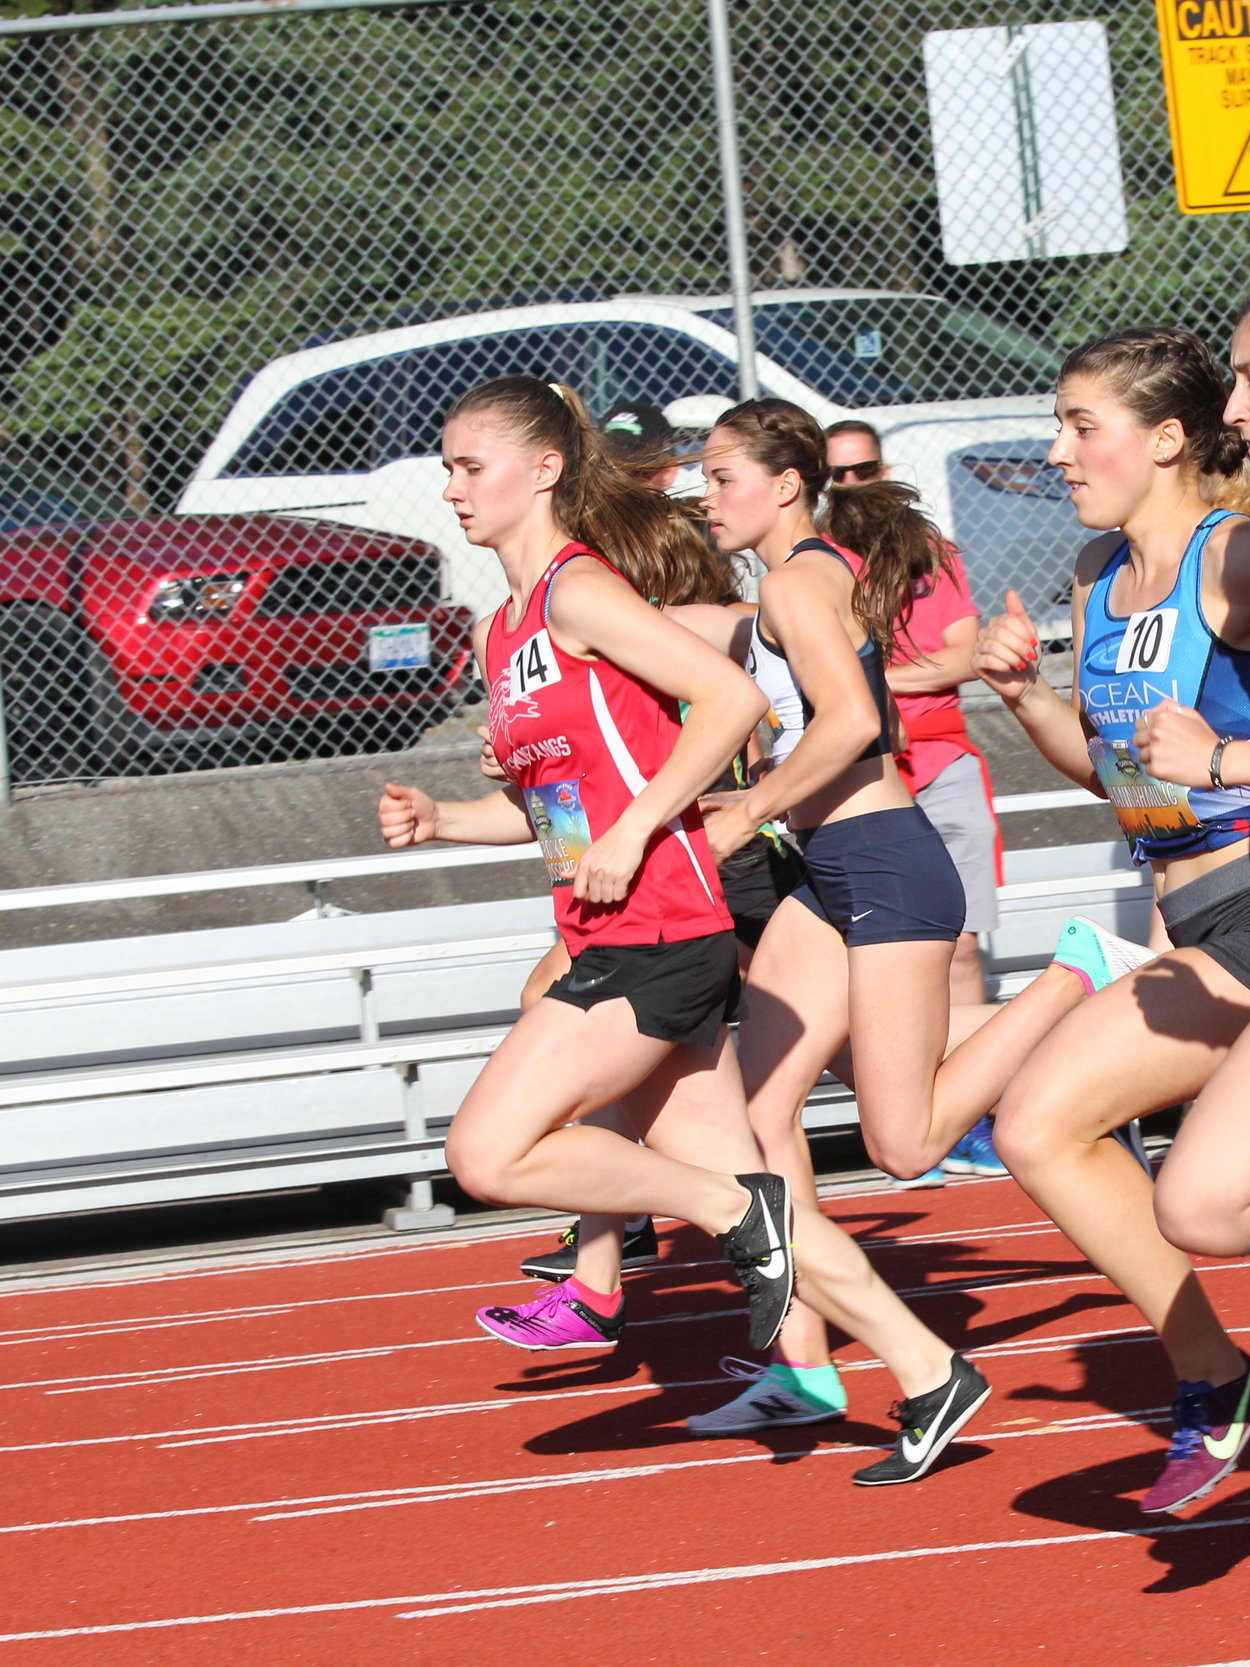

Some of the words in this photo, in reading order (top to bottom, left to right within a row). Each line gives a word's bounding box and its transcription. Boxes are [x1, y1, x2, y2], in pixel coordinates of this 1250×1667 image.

[1187, 45, 1241, 65] TRACK
[515, 637, 548, 693] 14
[1128, 613, 1163, 669] 10
